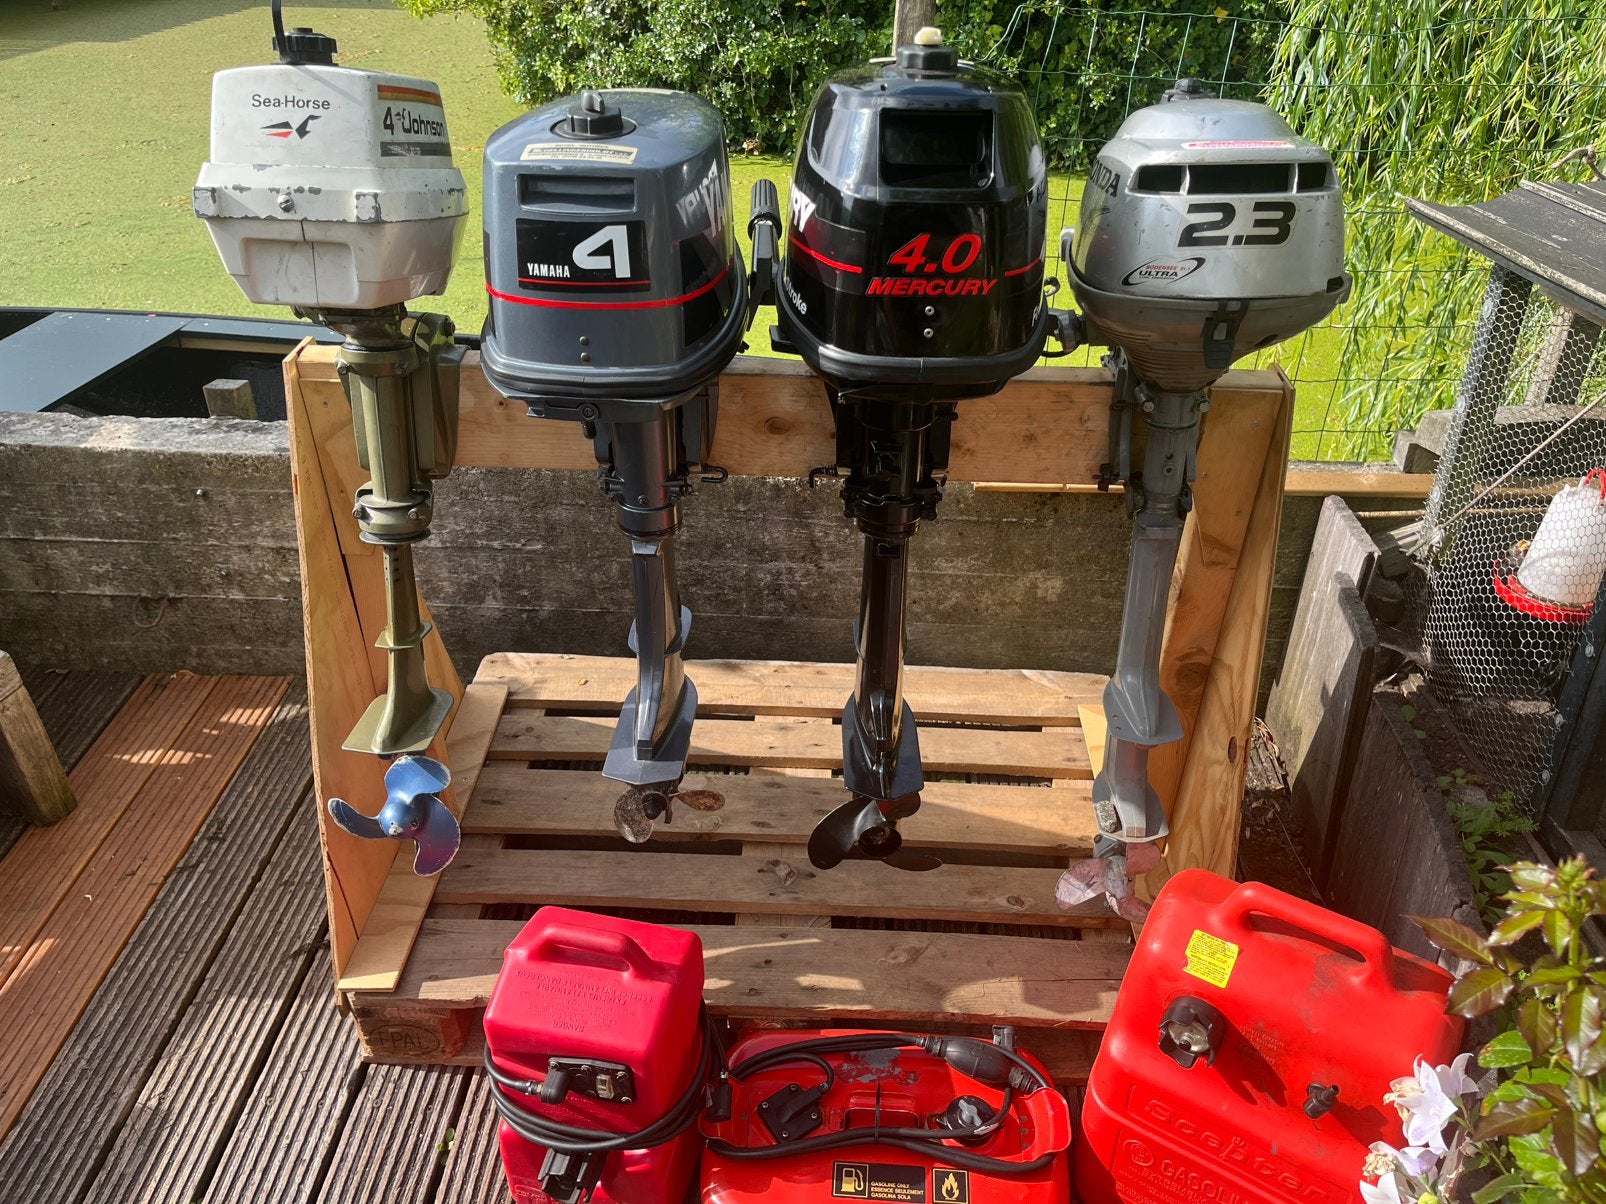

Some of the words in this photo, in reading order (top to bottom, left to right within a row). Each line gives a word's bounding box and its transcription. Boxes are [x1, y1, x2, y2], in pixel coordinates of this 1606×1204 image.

[382, 106, 395, 136] 4
[401, 108, 446, 138] Johnson
[1177, 201, 1297, 248] 2.3
[527, 262, 571, 278] YAMAHA
[572, 225, 631, 279] 4
[887, 233, 983, 274] 4.0
[865, 277, 998, 296] MERCURY
